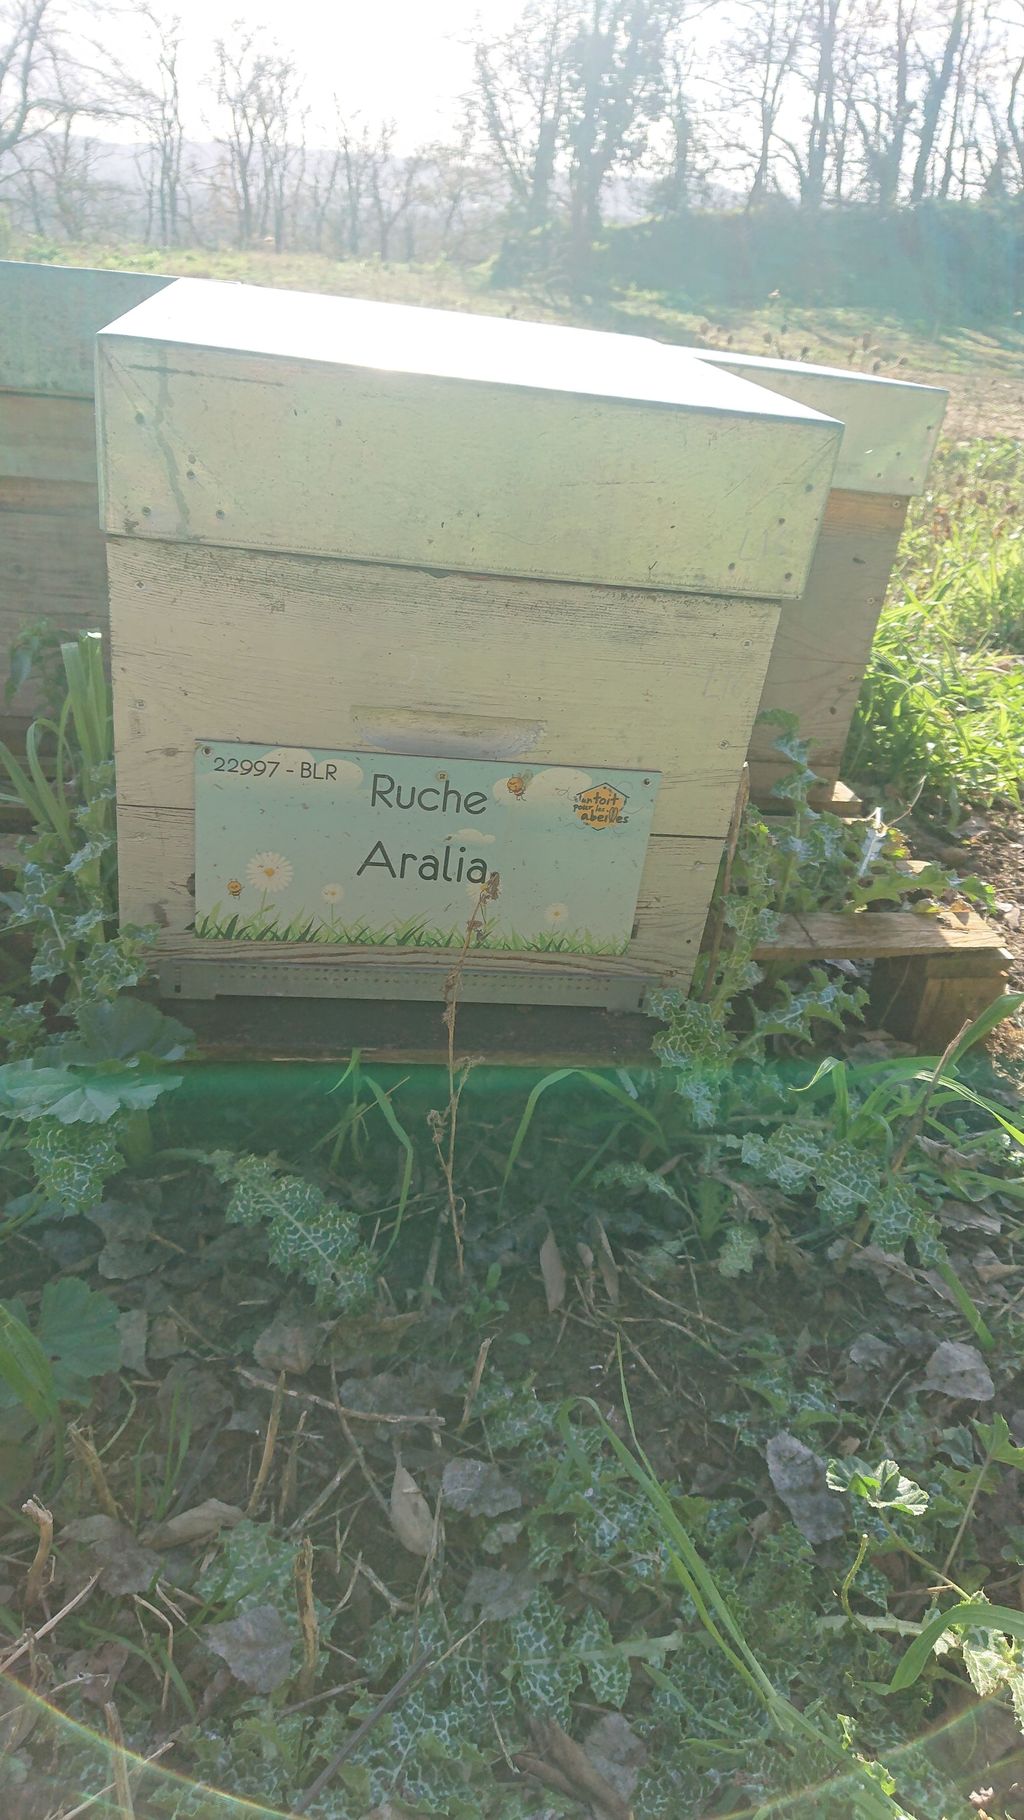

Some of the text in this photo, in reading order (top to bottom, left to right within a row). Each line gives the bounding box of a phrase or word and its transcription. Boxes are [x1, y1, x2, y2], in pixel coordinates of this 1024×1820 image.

[213, 756, 281, 778] 22997
[300, 761, 338, 781] BLR
[371, 773, 488, 815] Ruche
[593, 791, 620, 806] toit
[580, 806, 630, 824] abeilles
[356, 840, 488, 884] Aralia
